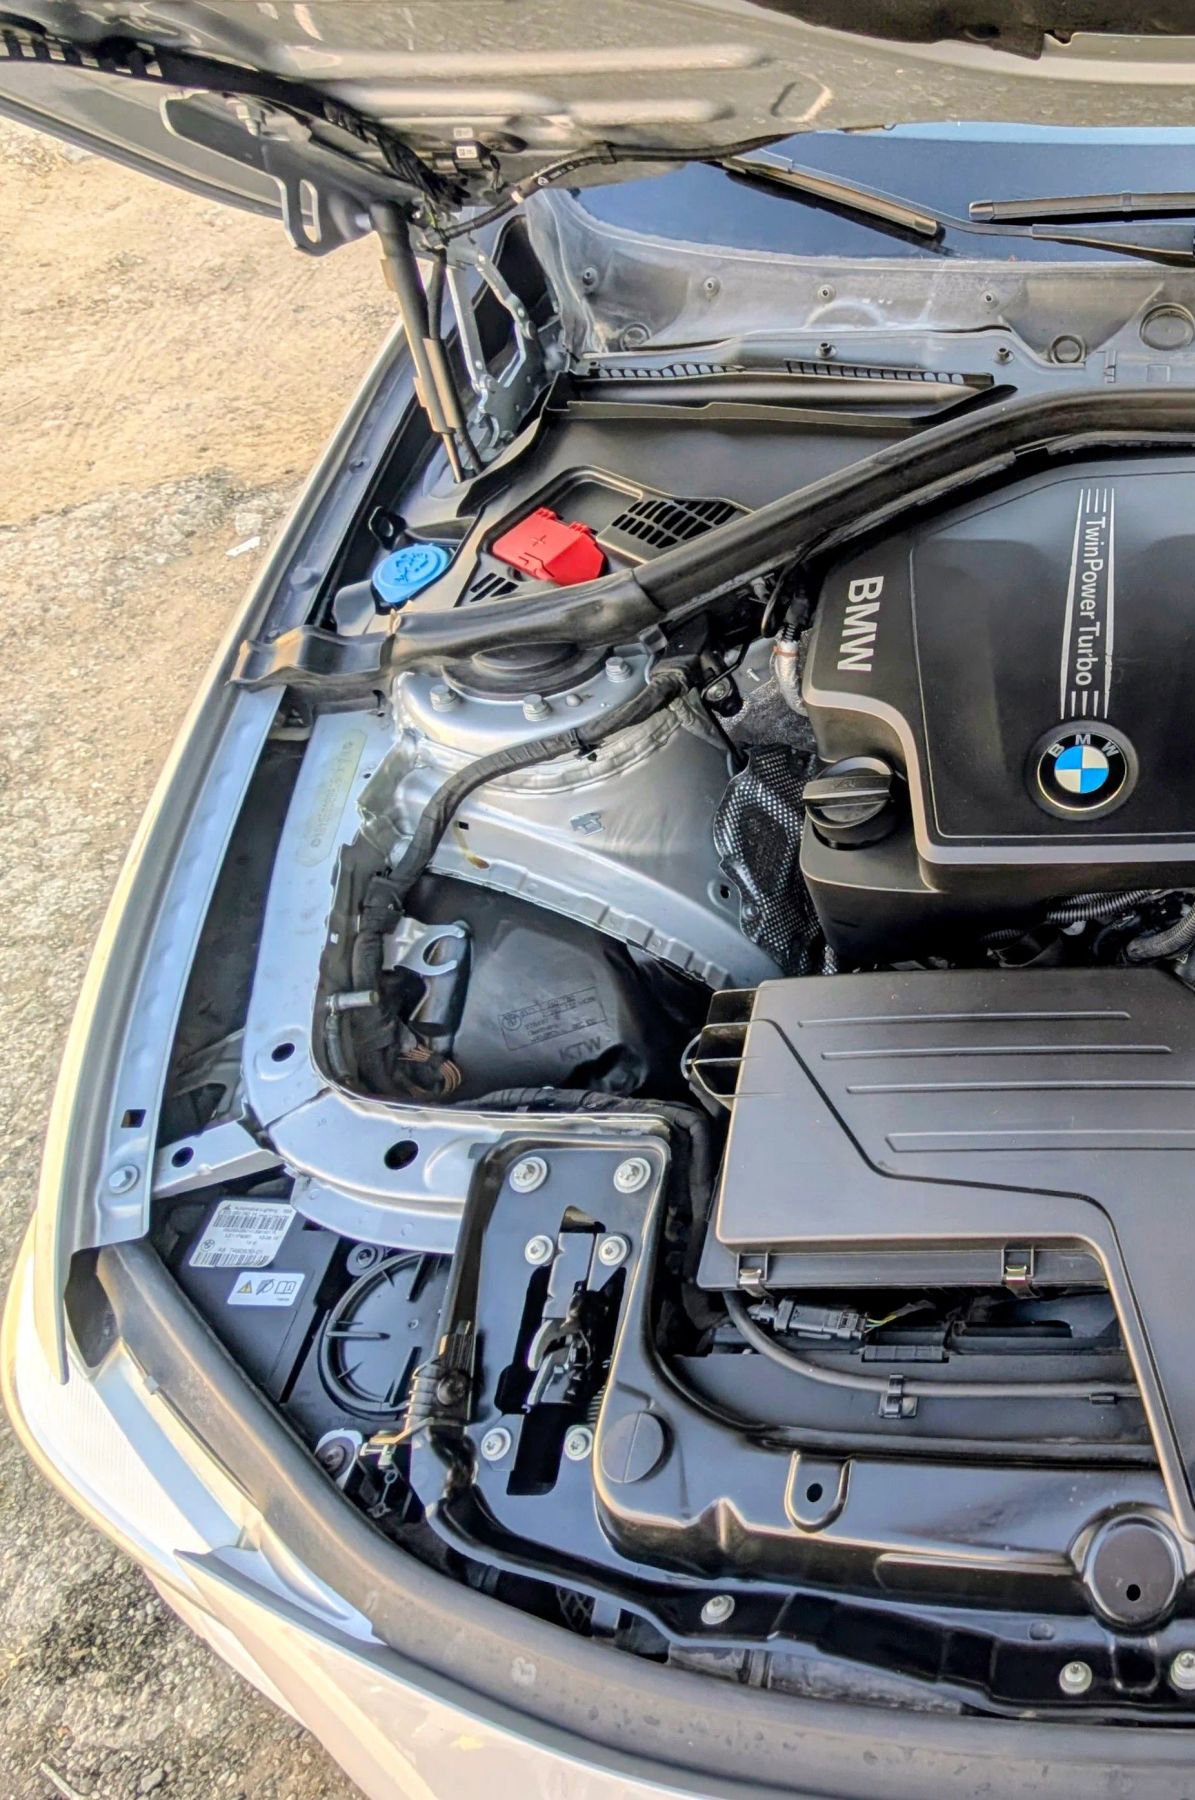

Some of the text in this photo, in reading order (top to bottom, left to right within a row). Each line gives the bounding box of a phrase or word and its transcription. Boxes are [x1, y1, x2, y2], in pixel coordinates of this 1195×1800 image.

[837, 575, 884, 672] BMW
[1075, 516, 1106, 686] TwinPower Turbo
[1048, 733, 1119, 758] BMW
